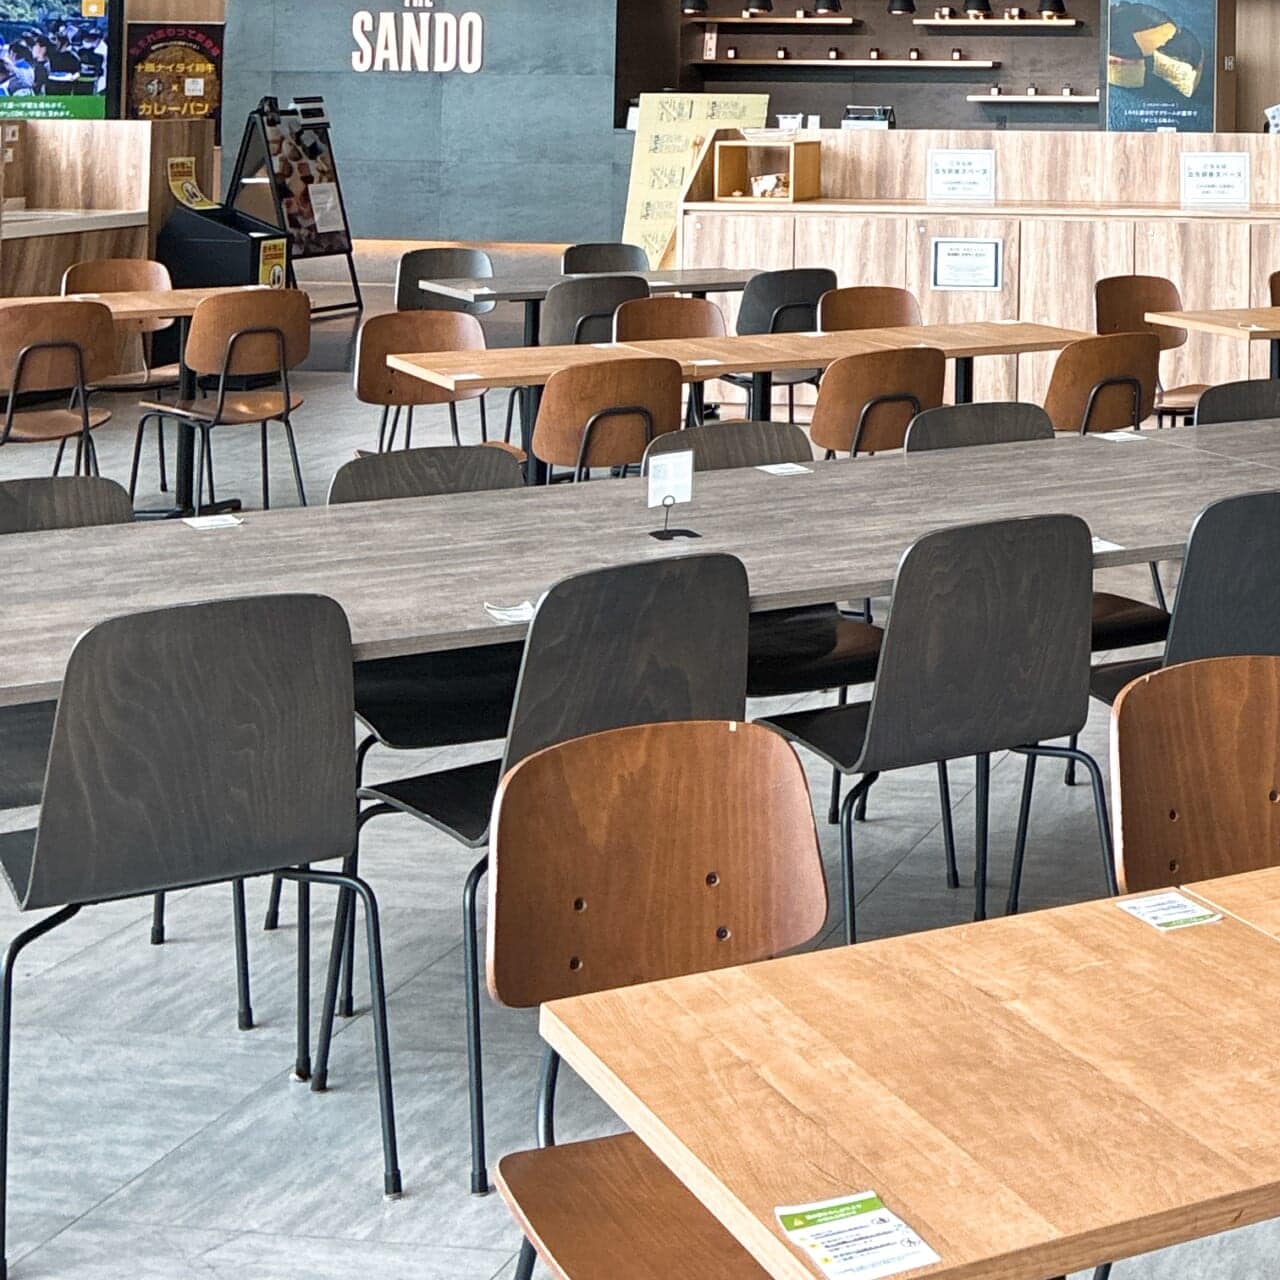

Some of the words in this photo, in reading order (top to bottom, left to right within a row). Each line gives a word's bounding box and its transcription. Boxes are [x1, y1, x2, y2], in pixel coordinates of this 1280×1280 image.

[351, 11, 483, 74] SANDO
[138, 102, 209, 116] カレーパン
